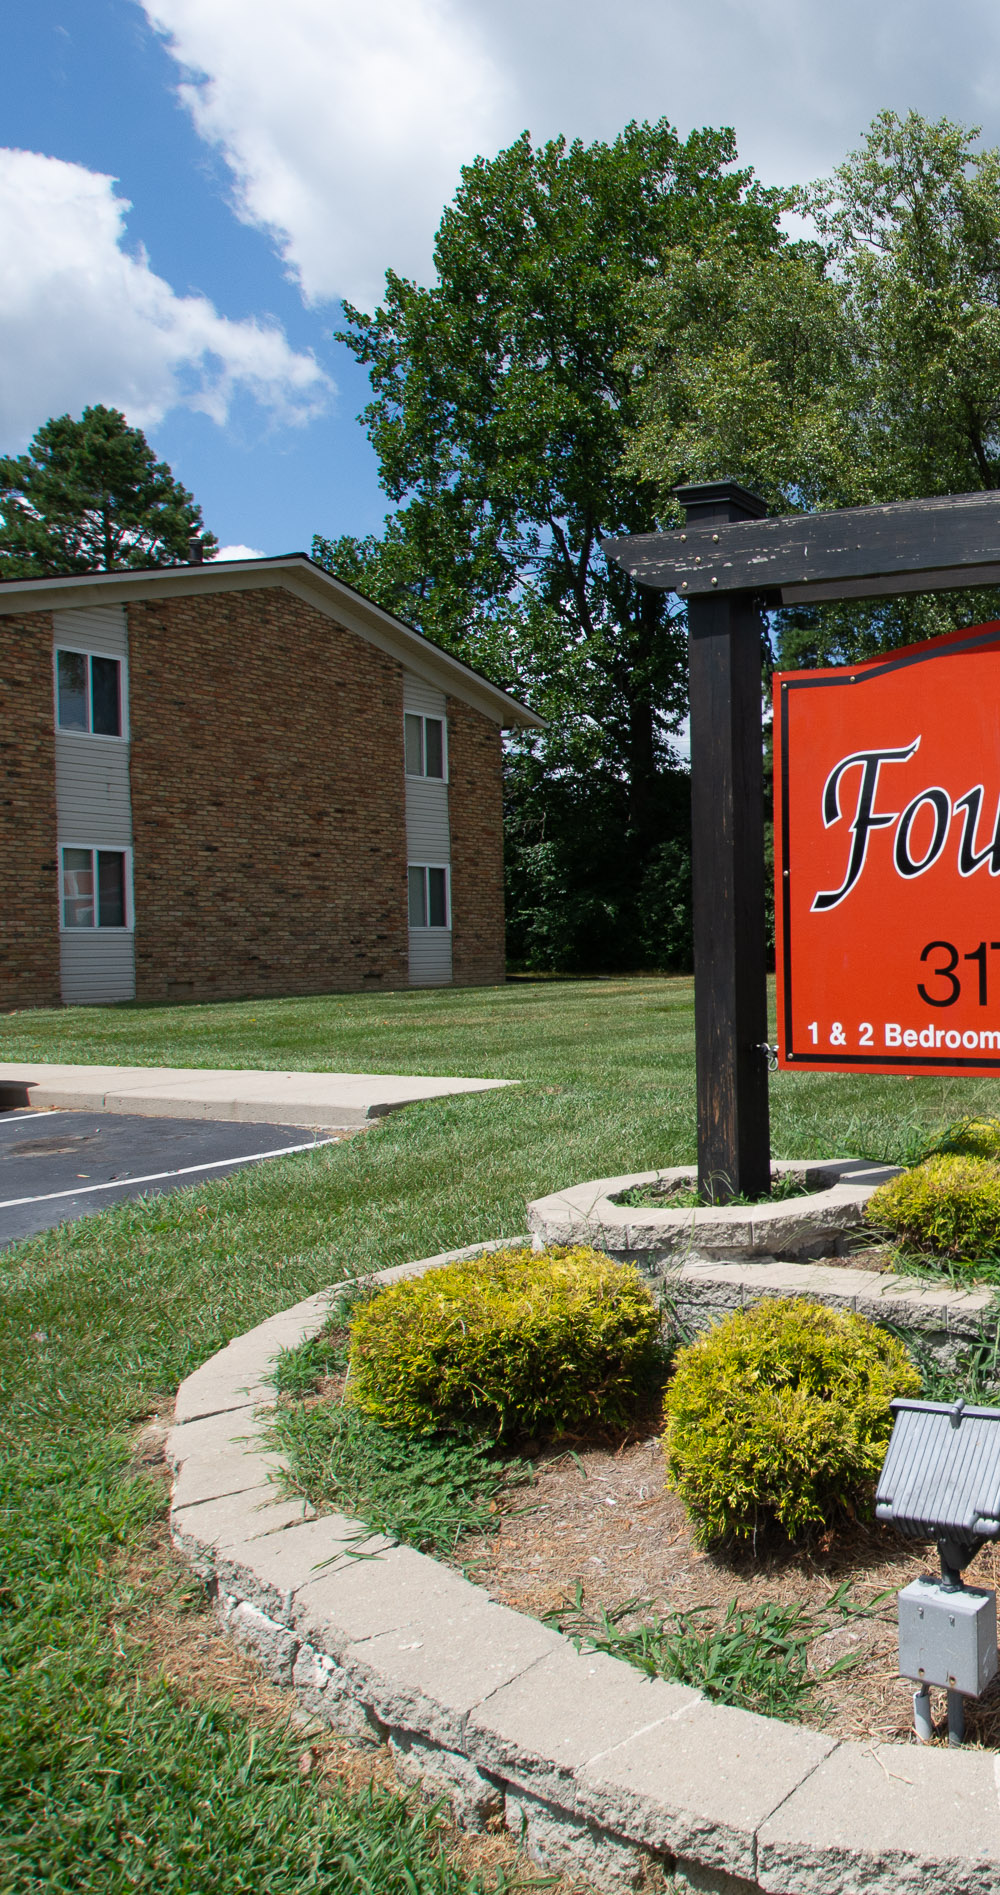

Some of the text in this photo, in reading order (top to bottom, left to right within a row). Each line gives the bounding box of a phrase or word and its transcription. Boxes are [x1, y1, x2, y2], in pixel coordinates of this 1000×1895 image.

[807, 1021, 819, 1045] 1
[829, 1021, 847, 1046] &
[858, 1022, 874, 1046] 2
